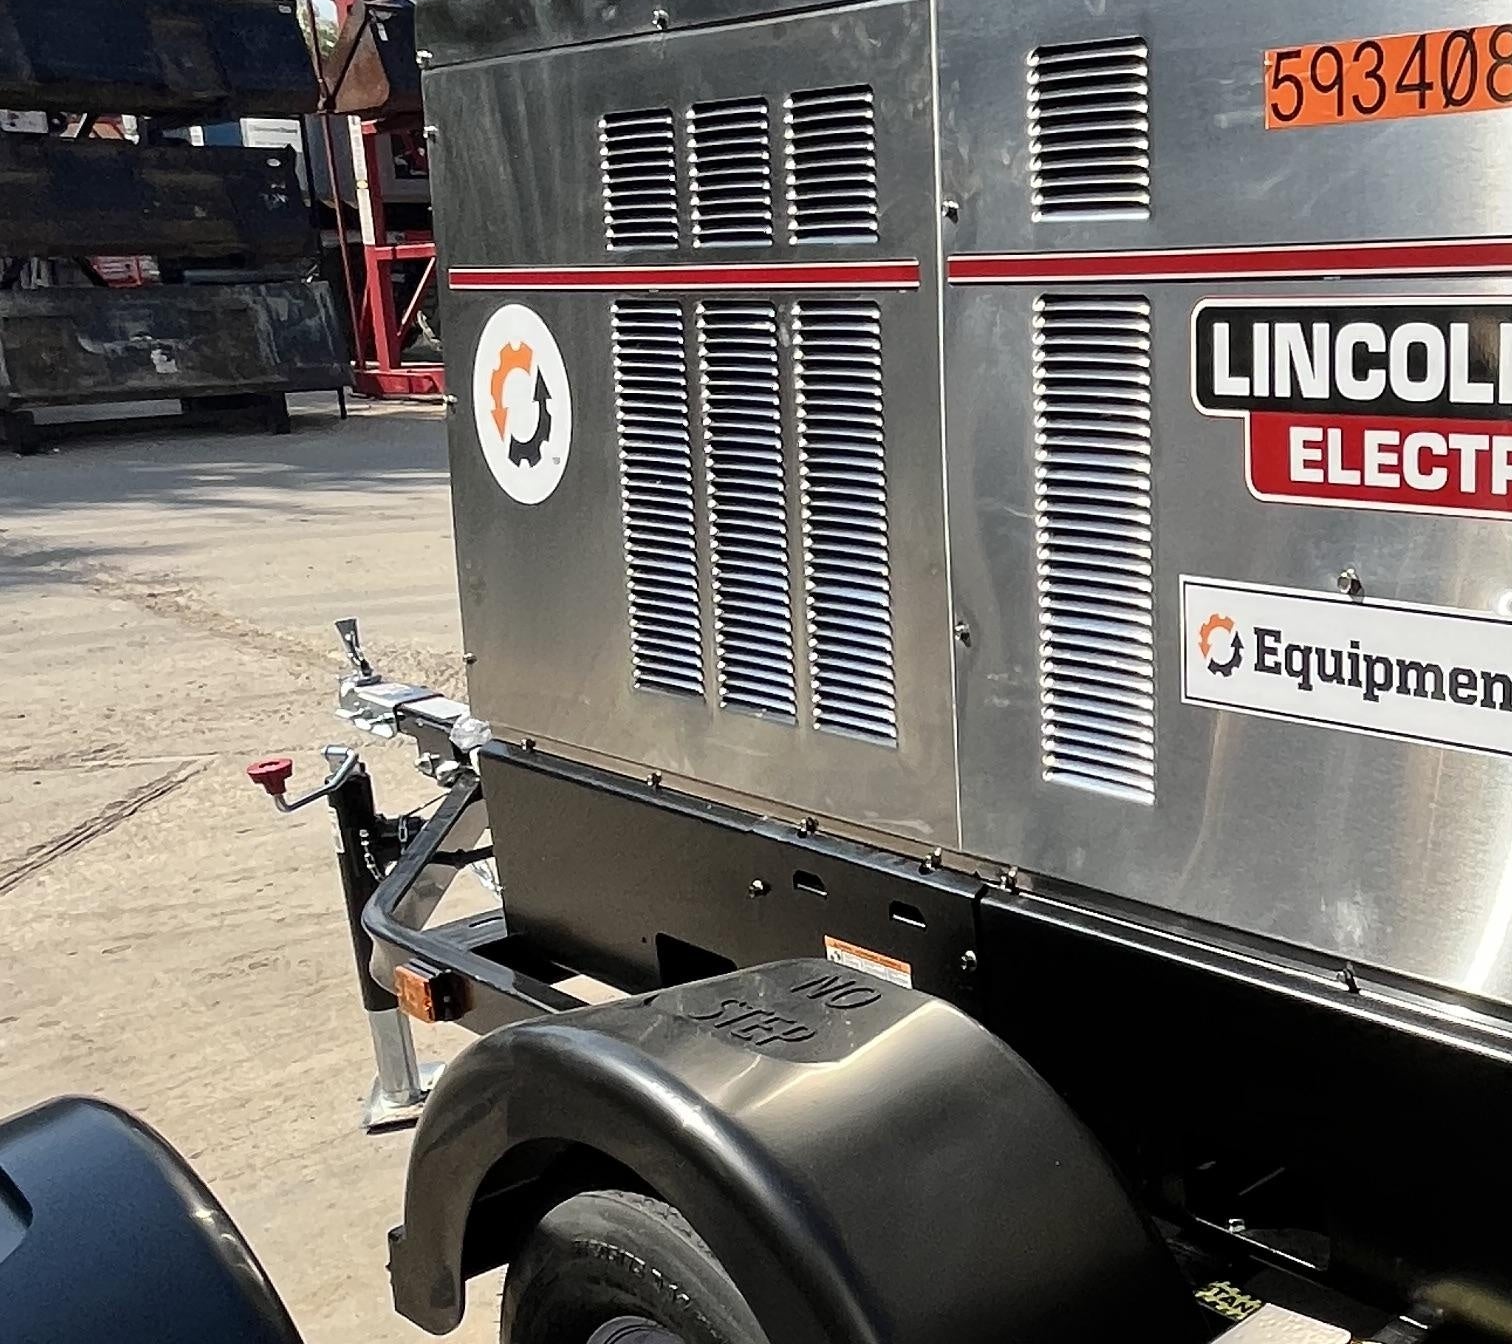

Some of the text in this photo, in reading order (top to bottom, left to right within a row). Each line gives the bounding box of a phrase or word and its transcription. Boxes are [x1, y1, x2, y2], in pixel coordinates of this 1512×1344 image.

[790, 975, 882, 1010] NO
[688, 999, 817, 1046] STEP
[1211, 1288, 1251, 1314] TAN
